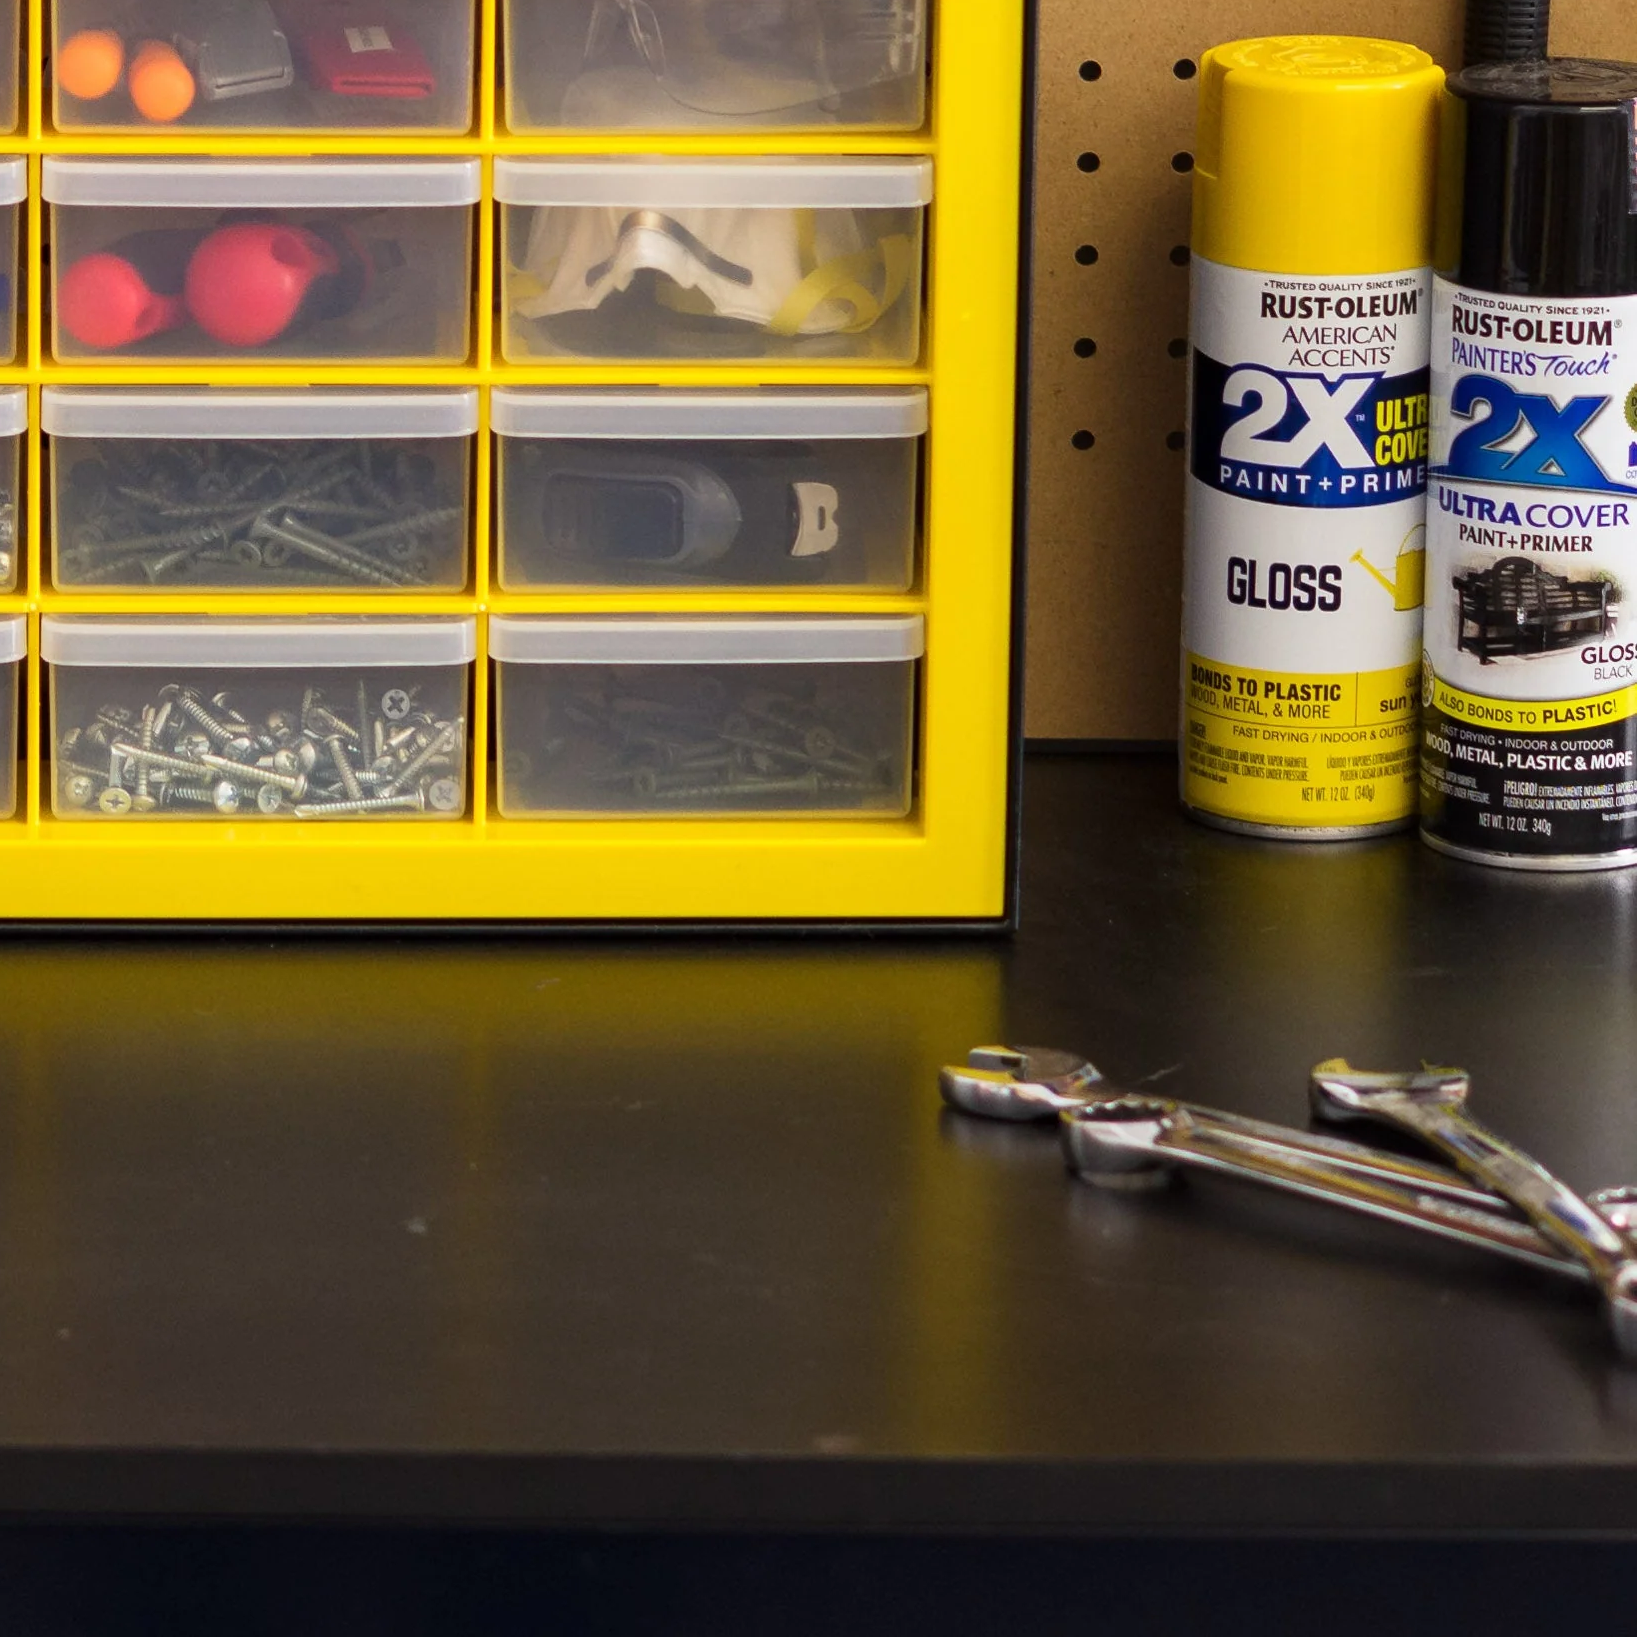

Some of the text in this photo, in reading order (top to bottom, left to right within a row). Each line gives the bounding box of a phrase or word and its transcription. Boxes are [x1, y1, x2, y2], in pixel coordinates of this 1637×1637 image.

[1269, 277, 1413, 292] TRUSTED QUALITY SINCE 1921
[1261, 289, 1418, 319] RUST-OLEUM
[1458, 292, 1605, 315] TRUSTED QUALITY SINCE 1921
[1282, 323, 1397, 345] AMERICAN
[1452, 304, 1613, 346] RUST-OLEUM
[1288, 346, 1391, 367] ACCENTS
[1452, 337, 1610, 377] PAINTER'S Touch
[1220, 369, 1376, 469] 2X
[1376, 393, 1428, 433] ULTR
[1449, 374, 1613, 483] 2X
[1375, 427, 1428, 466] COVE
[1220, 464, 1426, 494] PAINT+PRIME
[1438, 485, 1630, 529] ULTRA COVER
[1227, 556, 1342, 612] GLOSS
[1581, 643, 1637, 664] GLOS
[1191, 663, 1341, 702] BONDS TO PLASTIC
[1594, 664, 1633, 680] BLACK
[1223, 697, 1268, 719] METAL,
[1272, 704, 1283, 717] &
[1288, 704, 1331, 719] MORE
[1379, 695, 1407, 713] sun
[1439, 691, 1464, 713] ALSO
[1467, 703, 1513, 723] BONDS
[1518, 711, 1537, 724] TO
[1543, 699, 1618, 724] PLASTIC!
[1232, 725, 1260, 739] FAST
[1263, 729, 1309, 743] DRYING
[1320, 731, 1367, 743] INDOOR
[1369, 730, 1377, 741] &
[1379, 723, 1416, 740] OUTDO
[1440, 723, 1614, 751] FAST DRYING INDOOR & OUTDOOR
[1267, 754, 1283, 767] VAPOR
[1426, 730, 1633, 772] WOOD, METAL, PLASTIC & MORE
[1242, 764, 1265, 779] CONTENTS
[1266, 767, 1282, 780] UNDER
[1302, 787, 1313, 801] NET
[1330, 787, 1338, 801] 12
[1354, 784, 1375, 802] (340g)
[1503, 780, 1537, 797] ¡PELIGRO!
[1503, 796, 1523, 808] PUEDEN
[1524, 797, 1545, 809] CAUSAR
[1546, 799, 1554, 809] UN
[1555, 799, 1580, 810] INCENDIO
[1478, 813, 1552, 836] NET WT. 12 OZ. 340g
